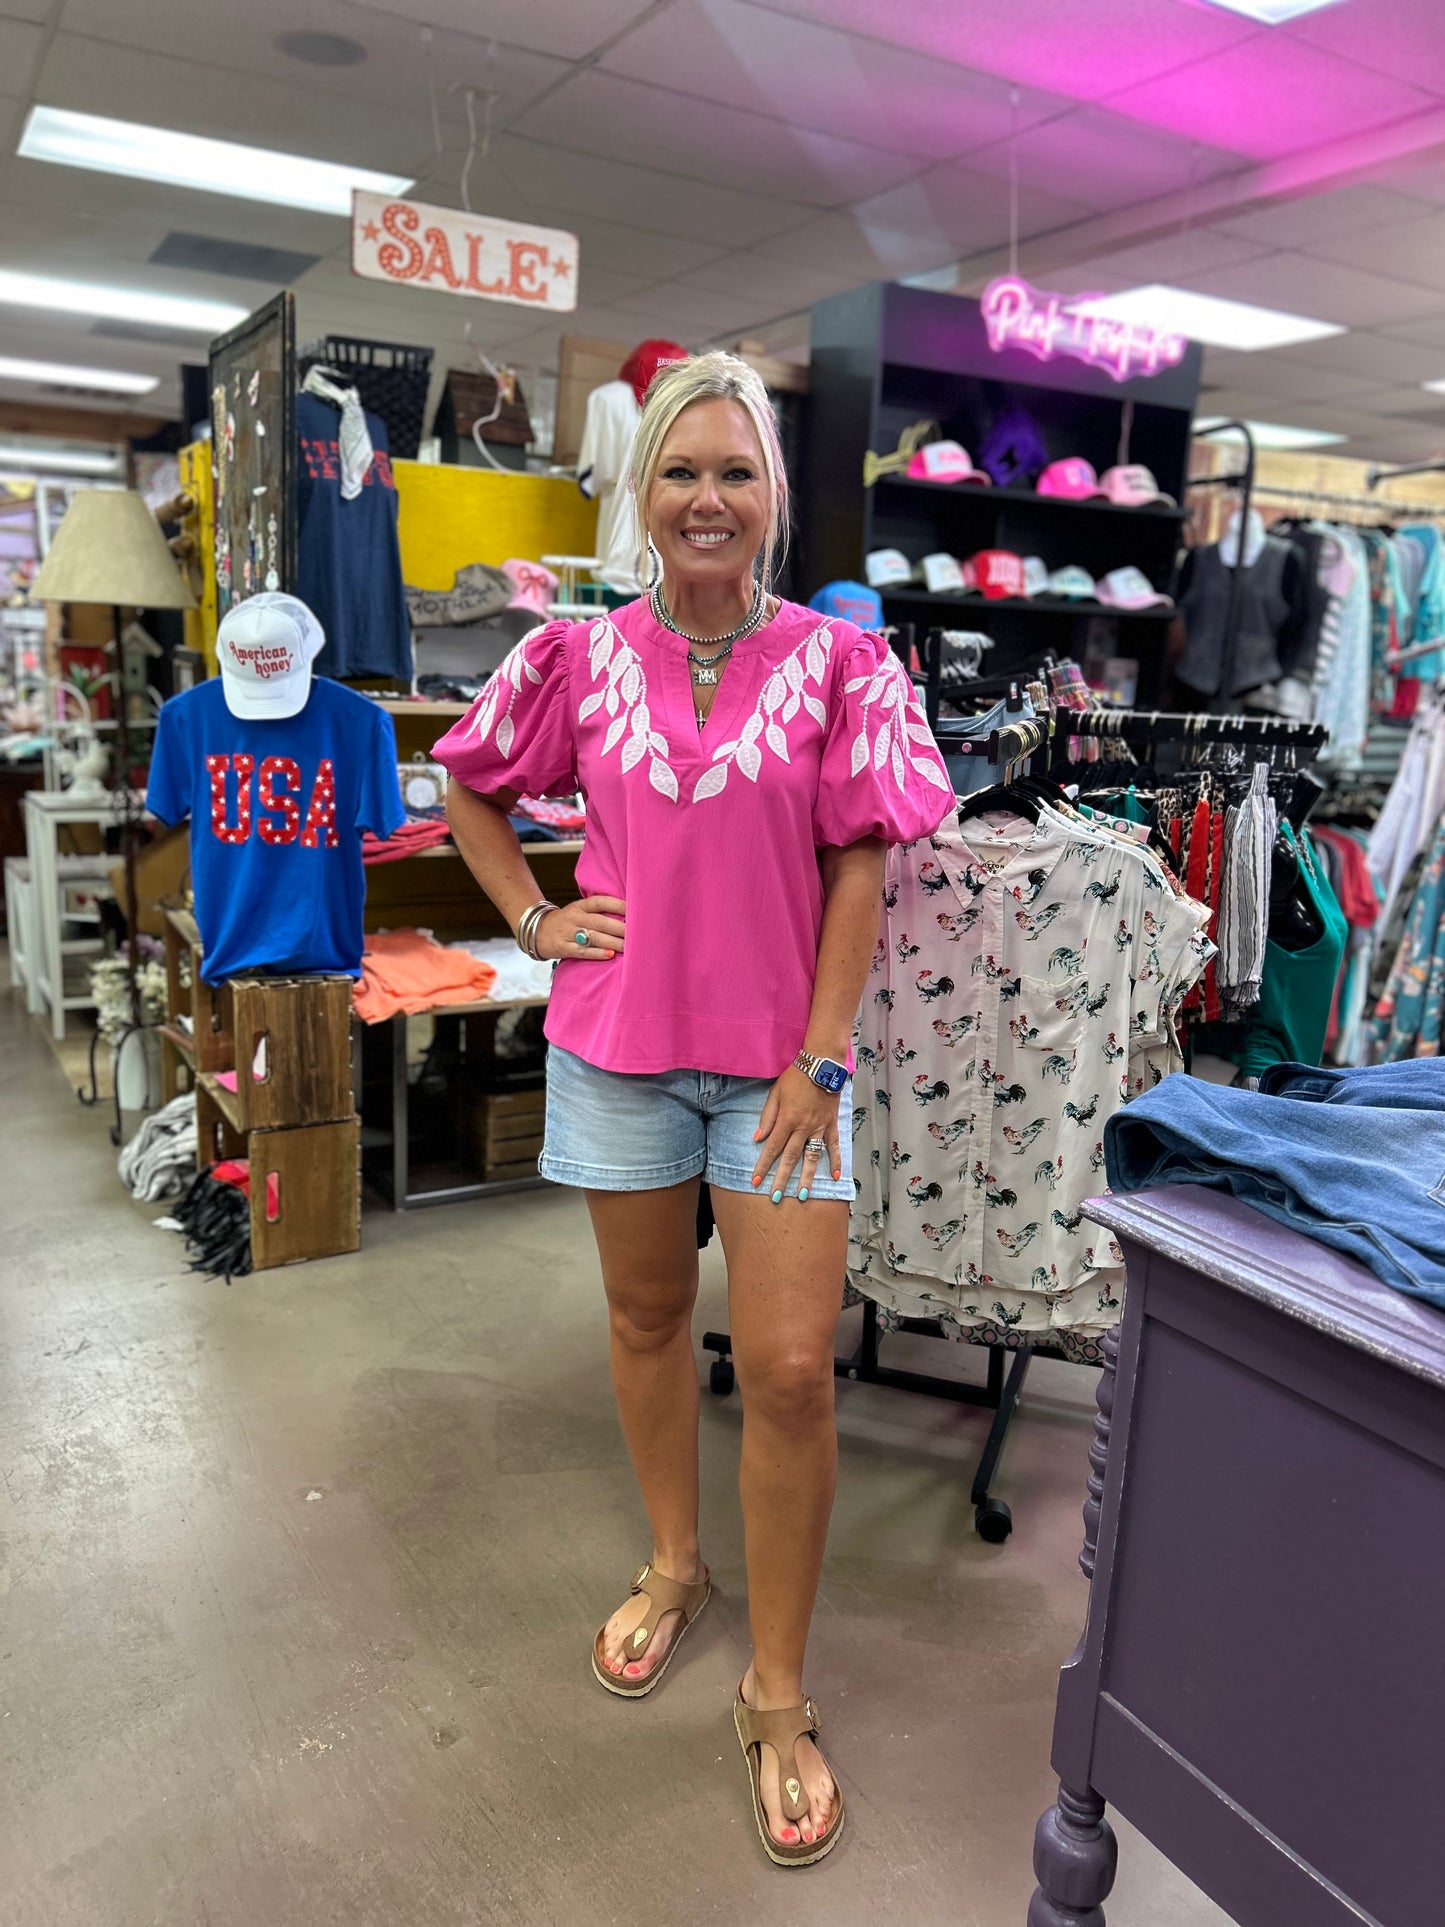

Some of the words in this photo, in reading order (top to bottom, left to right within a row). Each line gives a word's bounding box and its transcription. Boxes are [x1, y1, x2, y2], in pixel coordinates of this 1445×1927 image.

[378, 204, 549, 302] SALE
[229, 641, 287, 666] American
[254, 653, 294, 679] honey
[205, 753, 340, 849] USA
